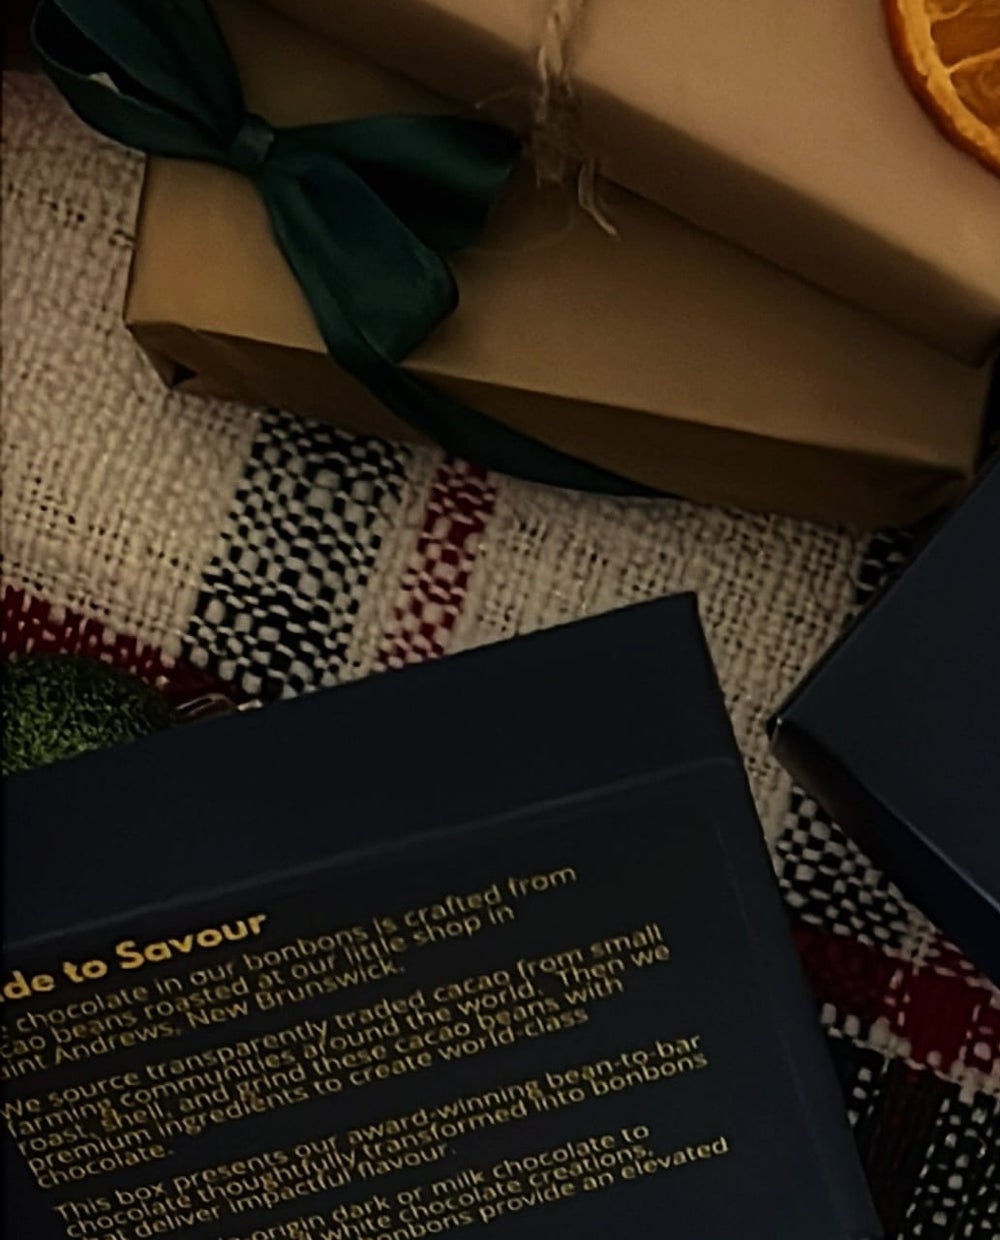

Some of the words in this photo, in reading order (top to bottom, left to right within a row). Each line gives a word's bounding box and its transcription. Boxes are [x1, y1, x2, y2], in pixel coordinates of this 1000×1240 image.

[0, 971, 55, 1002] de
[63, 960, 108, 983] to
[115, 915, 267, 970] Savour
[16, 988, 148, 1032] chocolate
[155, 978, 183, 994] in
[189, 964, 233, 986] our
[242, 928, 369, 971] bonbons
[373, 920, 397, 935] is
[404, 885, 501, 926] crafted
[508, 869, 577, 897] from
[50, 1014, 137, 1044] beans
[143, 977, 250, 1019] roasted
[258, 971, 284, 989] at
[291, 956, 334, 980] our
[344, 937, 405, 964] little
[413, 917, 481, 943] shop
[488, 907, 515, 924] in
[185, 1002, 248, 1028] New
[0, 1099, 40, 1120] We
[48, 1074, 138, 1104] source
[146, 1021, 328, 1080] transparently
[334, 991, 426, 1030] traded
[433, 971, 510, 1002] cacao
[516, 950, 584, 980] from
[590, 925, 663, 955] small
[7, 1099, 118, 1138] farming
[120, 1052, 296, 1107] communities
[304, 1017, 400, 1059] around
[405, 1008, 451, 1030] the
[456, 979, 544, 1015] world.
[555, 959, 625, 987] Then
[630, 947, 670, 967] we
[179, 1084, 230, 1112] and
[235, 1063, 306, 1102] grind
[312, 1044, 387, 1076] these
[394, 1023, 471, 1053] cacao
[475, 999, 560, 1031] beans
[564, 977, 623, 1005] with
[28, 1130, 152, 1176] premium
[157, 1088, 310, 1137] ingredients
[313, 1079, 342, 1095] to
[349, 1053, 432, 1086] create
[437, 1010, 589, 1061] world-class
[55, 1199, 111, 1220] This
[114, 1184, 164, 1205] box
[173, 1152, 294, 1197] presents
[294, 1137, 336, 1158] our
[348, 1081, 544, 1147] award-winning
[545, 1036, 700, 1089] bean-to-bar
[66, 1191, 191, 1237] chocolate
[197, 1151, 364, 1203] thoughtfully
[362, 1100, 528, 1159] transformed
[528, 1089, 585, 1111] into
[588, 1054, 708, 1096] bonbons
[134, 1207, 219, 1238] deliver
[228, 1167, 352, 1213] impactful
[332, 1196, 390, 1222] dark
[397, 1188, 421, 1205] or
[431, 1170, 485, 1196] milk
[492, 1136, 615, 1179] chocolate
[621, 1126, 649, 1143] to
[398, 1177, 521, 1223] chocolate
[478, 1183, 575, 1223] provide
[583, 1172, 614, 1191] an
[620, 1137, 729, 1179] elevated
